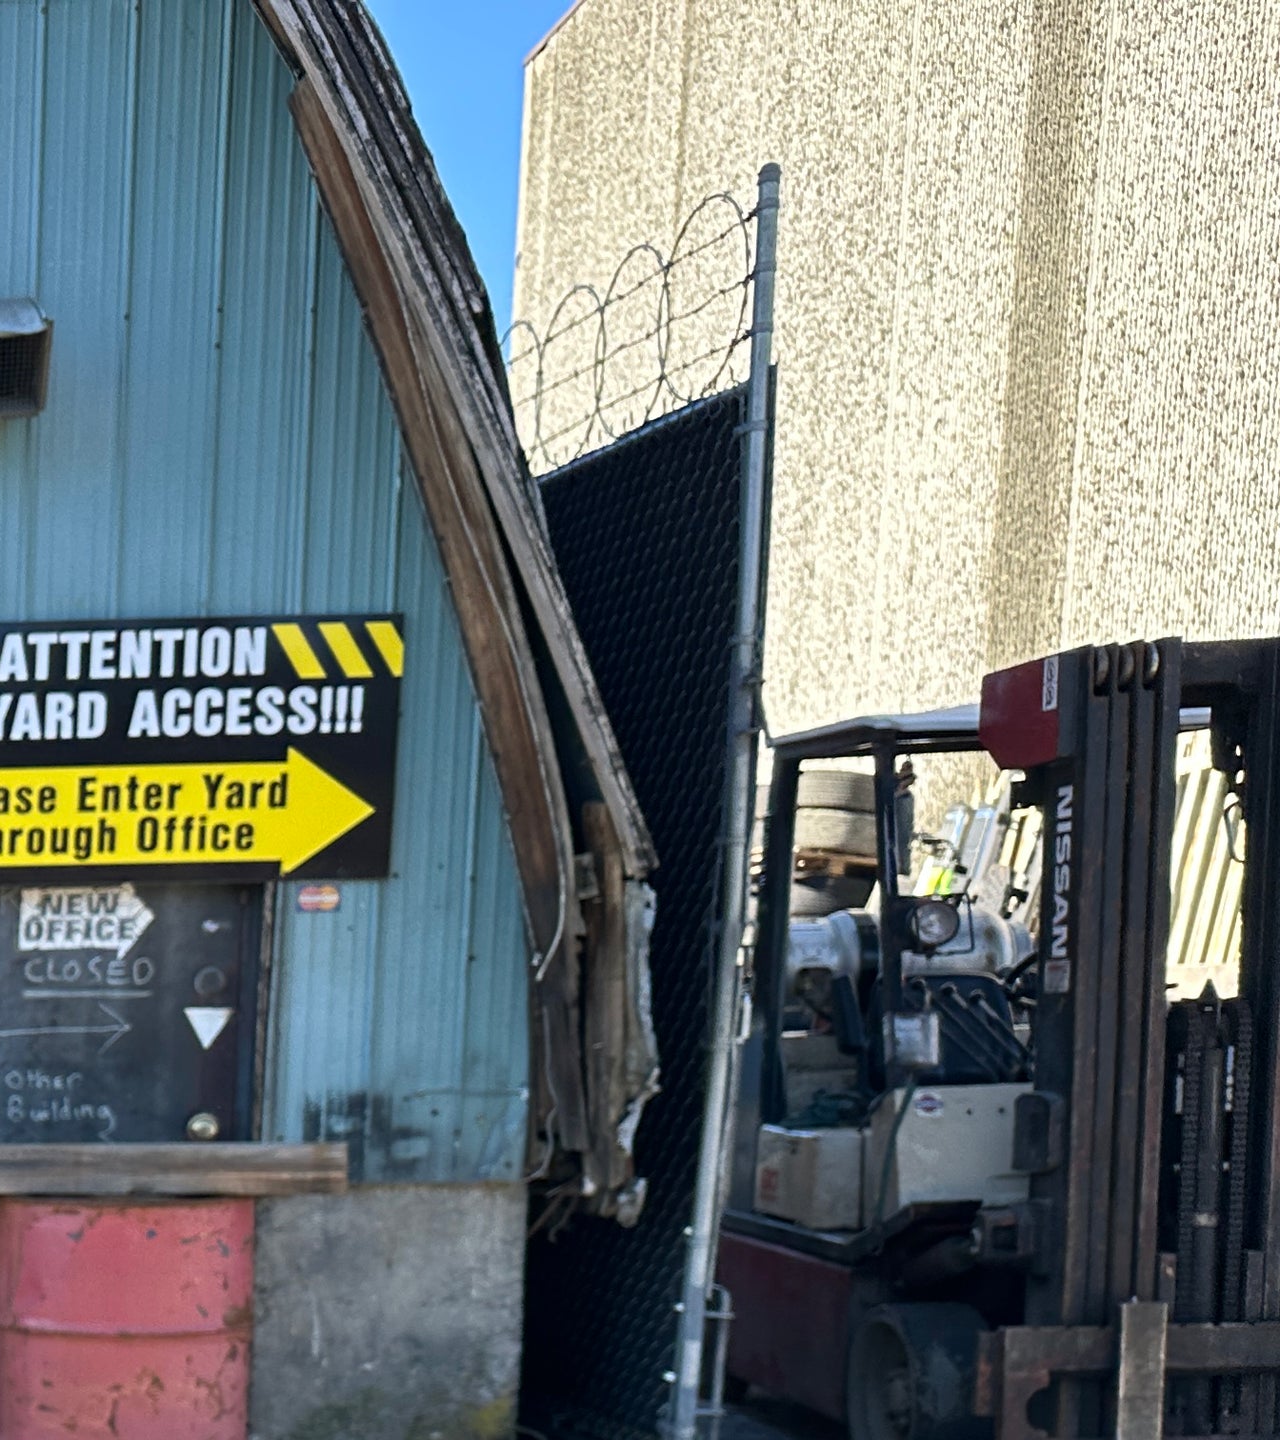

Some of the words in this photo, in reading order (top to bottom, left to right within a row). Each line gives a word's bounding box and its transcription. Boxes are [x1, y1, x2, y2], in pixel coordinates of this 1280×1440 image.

[127, 685, 365, 738] ACCESS!!!
[77, 776, 182, 812] Enter
[202, 773, 289, 809] Yard
[137, 815, 255, 852] Office
[1051, 784, 1074, 959] NISSAN
[40, 893, 120, 915] NEW
[24, 915, 136, 942] OFFICE
